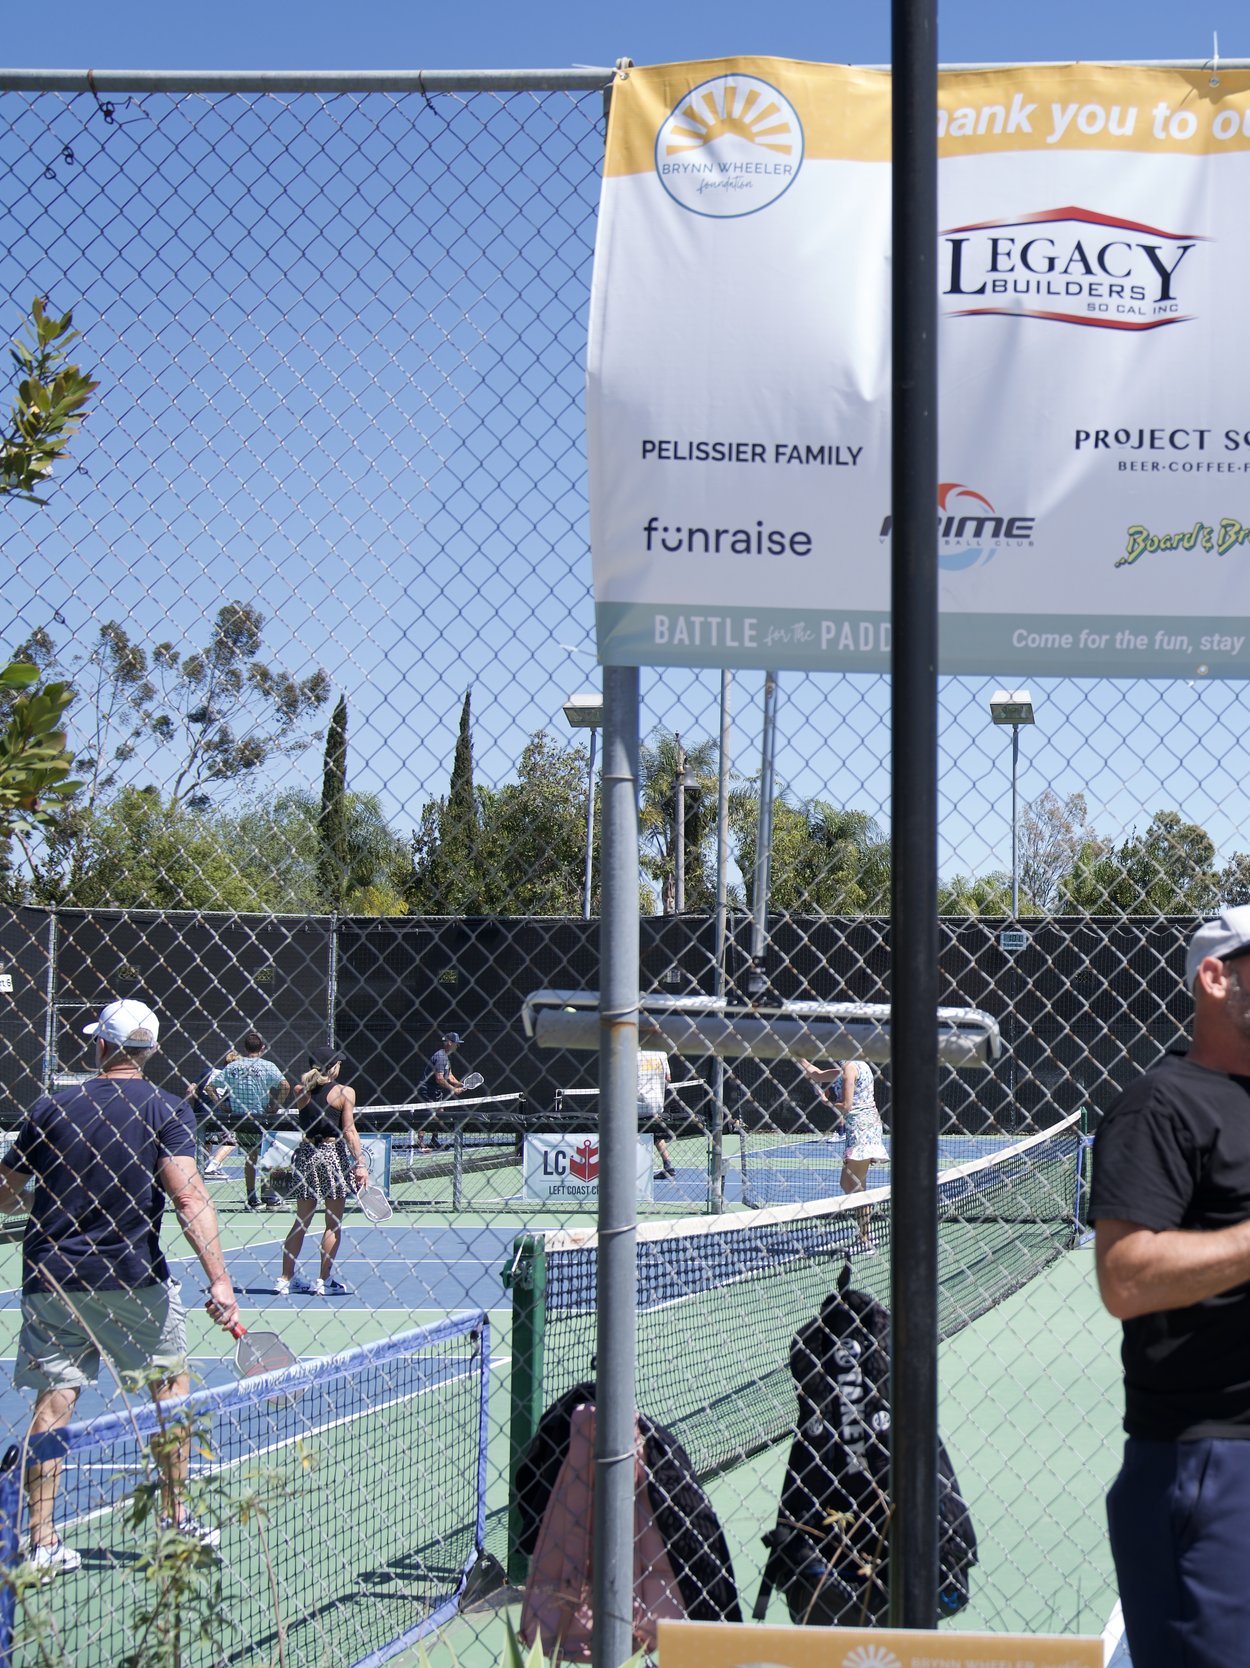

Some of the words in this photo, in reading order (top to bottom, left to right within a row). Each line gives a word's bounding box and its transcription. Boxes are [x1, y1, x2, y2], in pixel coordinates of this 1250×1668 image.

[937, 93, 1038, 139] ank
[1046, 102, 1138, 144] you
[1152, 102, 1198, 141] to
[661, 163, 714, 175] BRYNN
[719, 162, 793, 175] WHEELER
[696, 175, 754, 194] foundation
[942, 237, 1196, 304] LEGACY
[991, 279, 1146, 301] BUILDERS
[1086, 302, 1109, 312] SO
[1116, 304, 1147, 316] CAL
[1152, 303, 1179, 315] INC
[1074, 428, 1212, 450] PROJECT
[641, 439, 766, 463] PELISSIER
[774, 444, 864, 466] FAMILY
[994, 540, 1035, 548] CLUB
[1124, 522, 1203, 565] Board
[654, 614, 758, 648] BATTLE
[762, 626, 793, 647] for
[820, 620, 892, 652] PADD
[1012, 629, 1073, 649] Come
[1079, 630, 1110, 649] for
[1115, 630, 1148, 650] the
[1154, 630, 1193, 654] fun,
[1200, 632, 1245, 656] stay
[543, 1151, 567, 1176] LC
[549, 1186, 565, 1195] LEFT
[567, 1186, 591, 1195] COAST
